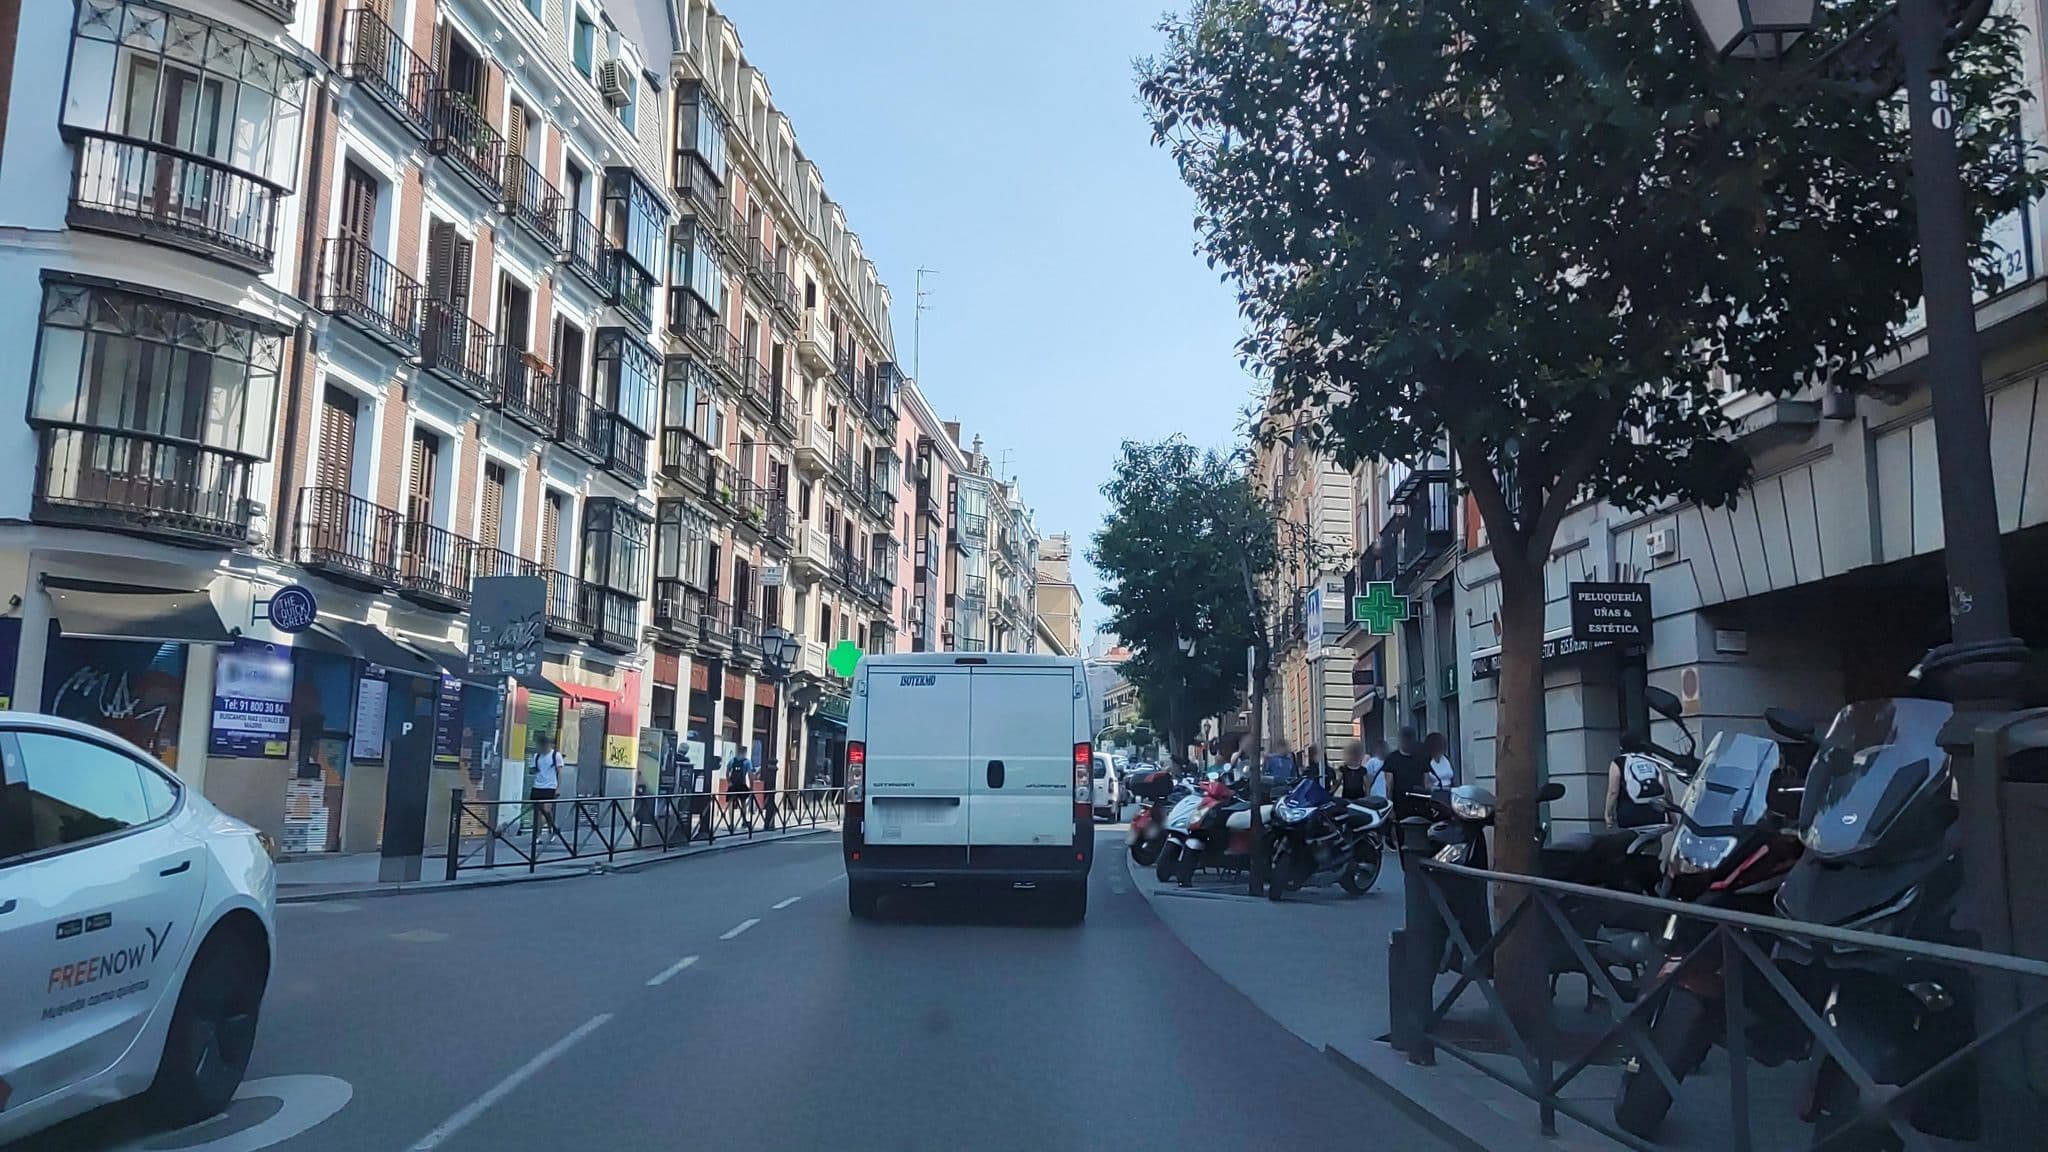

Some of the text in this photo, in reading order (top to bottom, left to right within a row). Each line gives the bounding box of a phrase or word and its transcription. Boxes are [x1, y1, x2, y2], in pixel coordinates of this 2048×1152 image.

[279, 596, 295, 609] THE
[1578, 591, 1643, 603] PELUQUERÍA
[281, 603, 307, 619] QUICK
[1593, 608, 1632, 618] UÑAS &
[283, 614, 311, 629] GREEK
[1588, 624, 1640, 633] ESTÉTICA
[240, 700, 249, 711] 91
[250, 701, 264, 712] 800
[265, 702, 274, 713] 30
[402, 722, 413, 735] P
